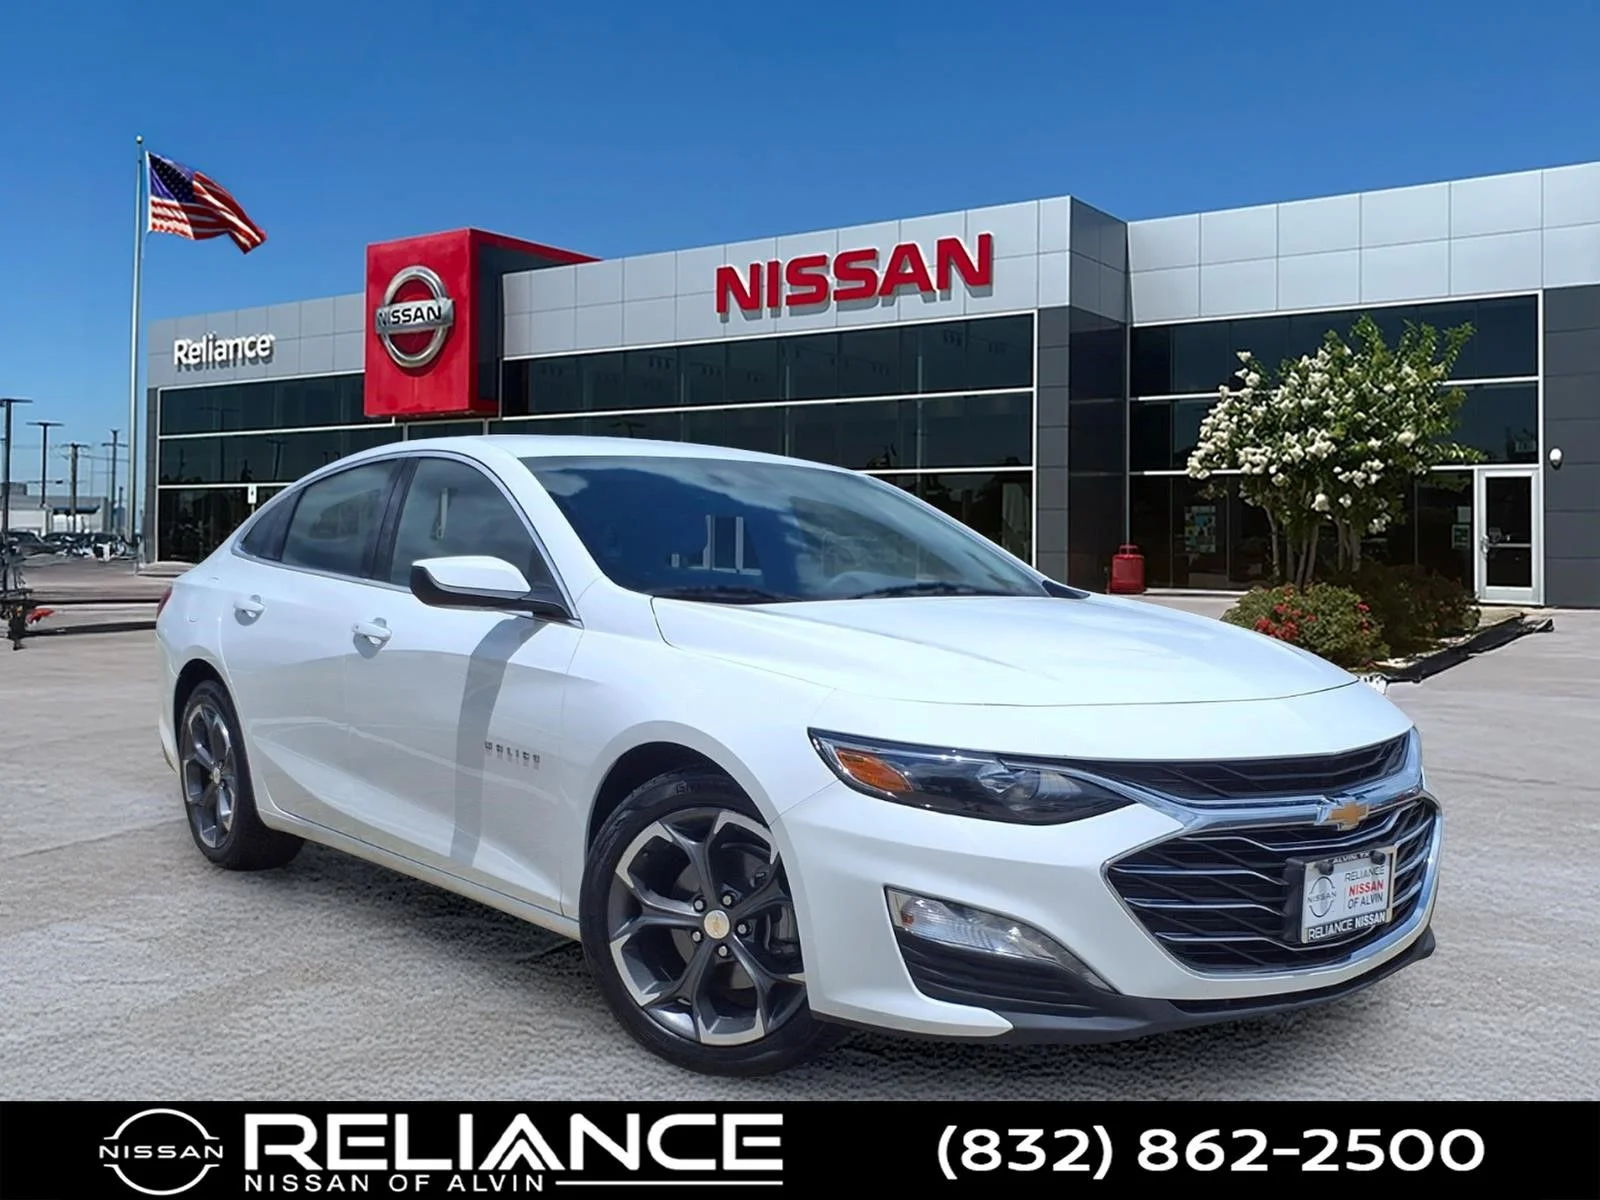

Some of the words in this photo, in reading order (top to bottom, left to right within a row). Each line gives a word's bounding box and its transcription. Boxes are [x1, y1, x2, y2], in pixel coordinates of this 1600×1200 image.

[716, 233, 991, 313] NISSAN
[378, 306, 442, 326] NISSAN
[173, 331, 275, 366] Reliance
[1345, 865, 1385, 881] RELIANCE
[1307, 890, 1337, 903] NISSAN
[1348, 880, 1384, 896] NISSAN
[1347, 897, 1359, 909] OF
[1360, 893, 1383, 906] ALVIN
[1308, 918, 1353, 940] RELIANCE
[1355, 912, 1385, 929] NISSAN
